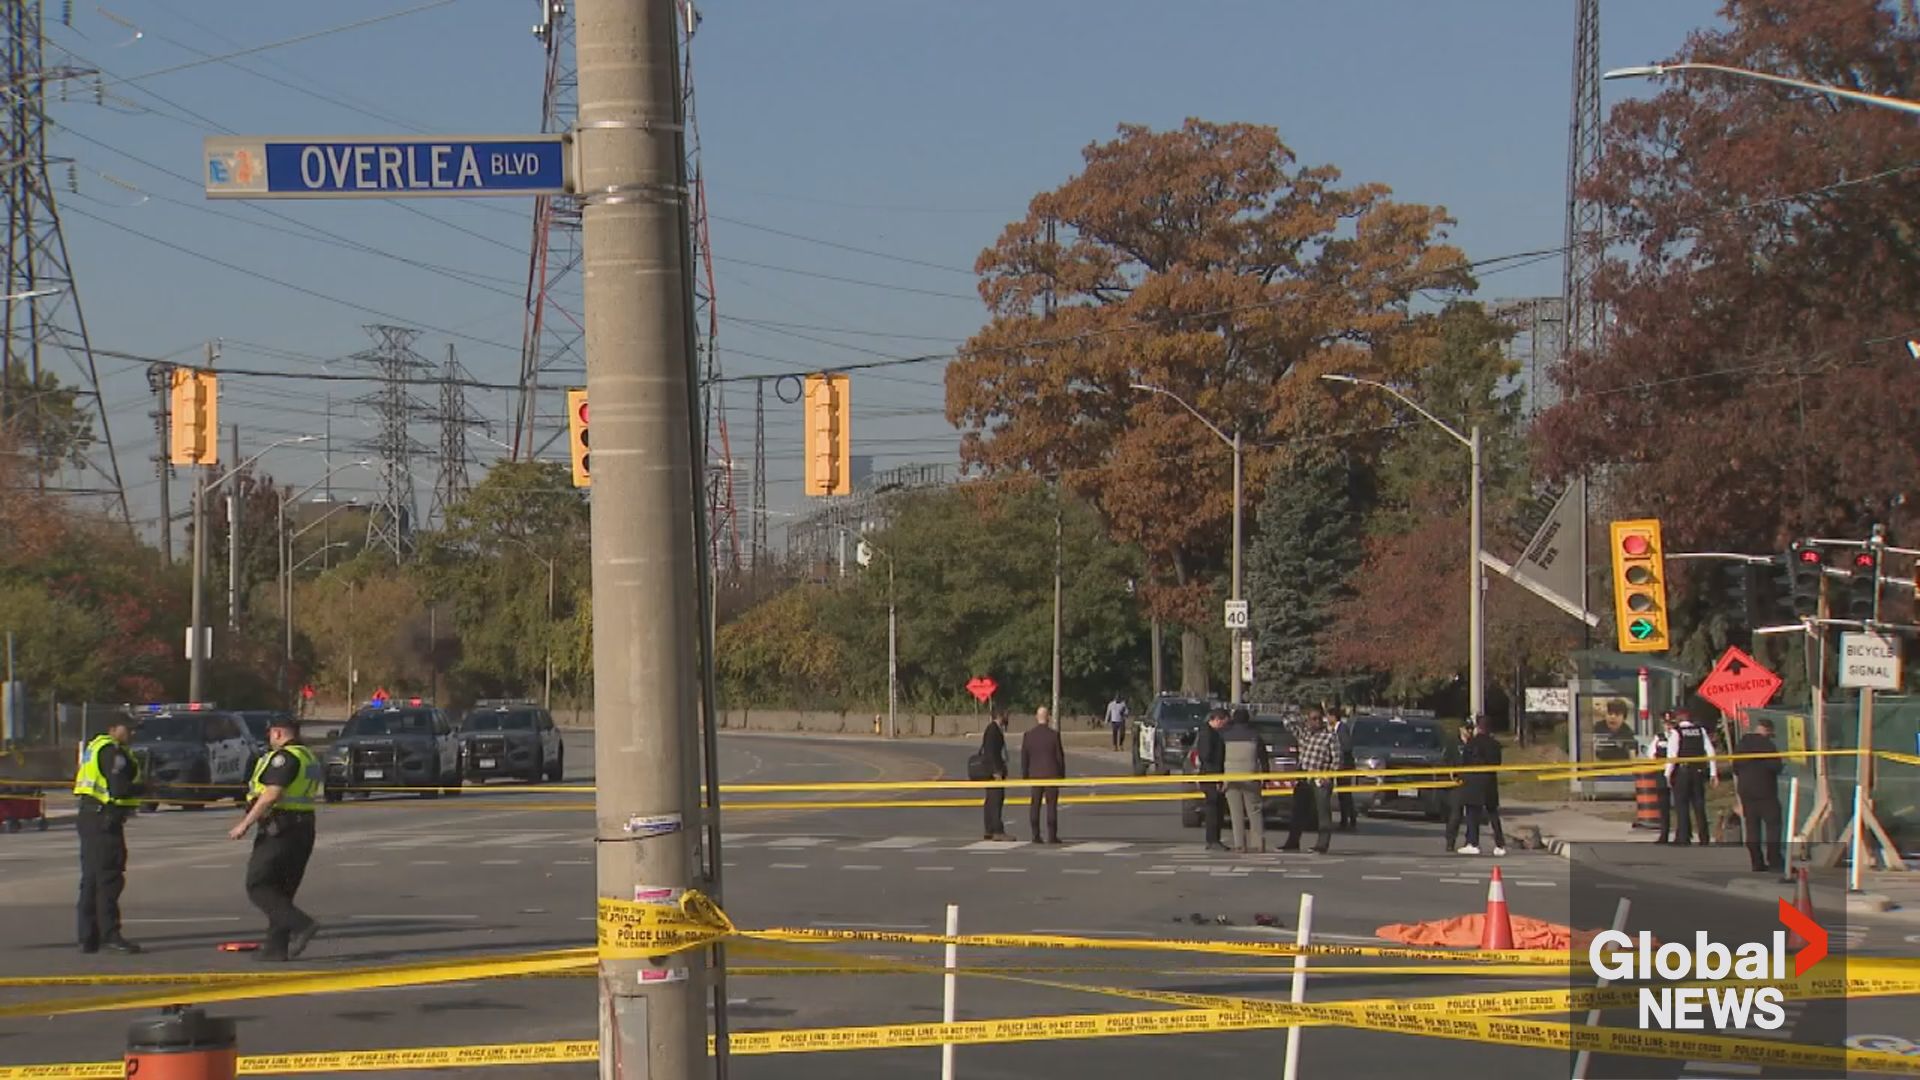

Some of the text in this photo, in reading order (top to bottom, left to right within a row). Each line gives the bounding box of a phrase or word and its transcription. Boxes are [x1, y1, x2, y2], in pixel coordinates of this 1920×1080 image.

[301, 145, 540, 189] OVERLEA BLVD
[1539, 547, 1559, 570] Park
[1228, 612, 1246, 624] 40
[1847, 645, 1895, 658] BICYCLE
[1848, 665, 1890, 678] SIGNAL
[1706, 679, 1772, 696] CONSTRUCTION
[1682, 728, 1701, 736] POLICE
[617, 929, 653, 940] POLICE
[1447, 1000, 1476, 1009] POLICE
[1107, 1017, 1134, 1026] POLICE
[1366, 1011, 1397, 1022] POLICE
[997, 1022, 1023, 1032] POLICE
[1489, 1022, 1521, 1034] POLICE
[1560, 1030, 1573, 1038] NOT
[1575, 1031, 1600, 1042] CROSS
[781, 1034, 807, 1042] POLICE
[1612, 1033, 1642, 1045] POLICE
[459, 1049, 485, 1057] POLICE
[1734, 1045, 1764, 1056] POLICE
